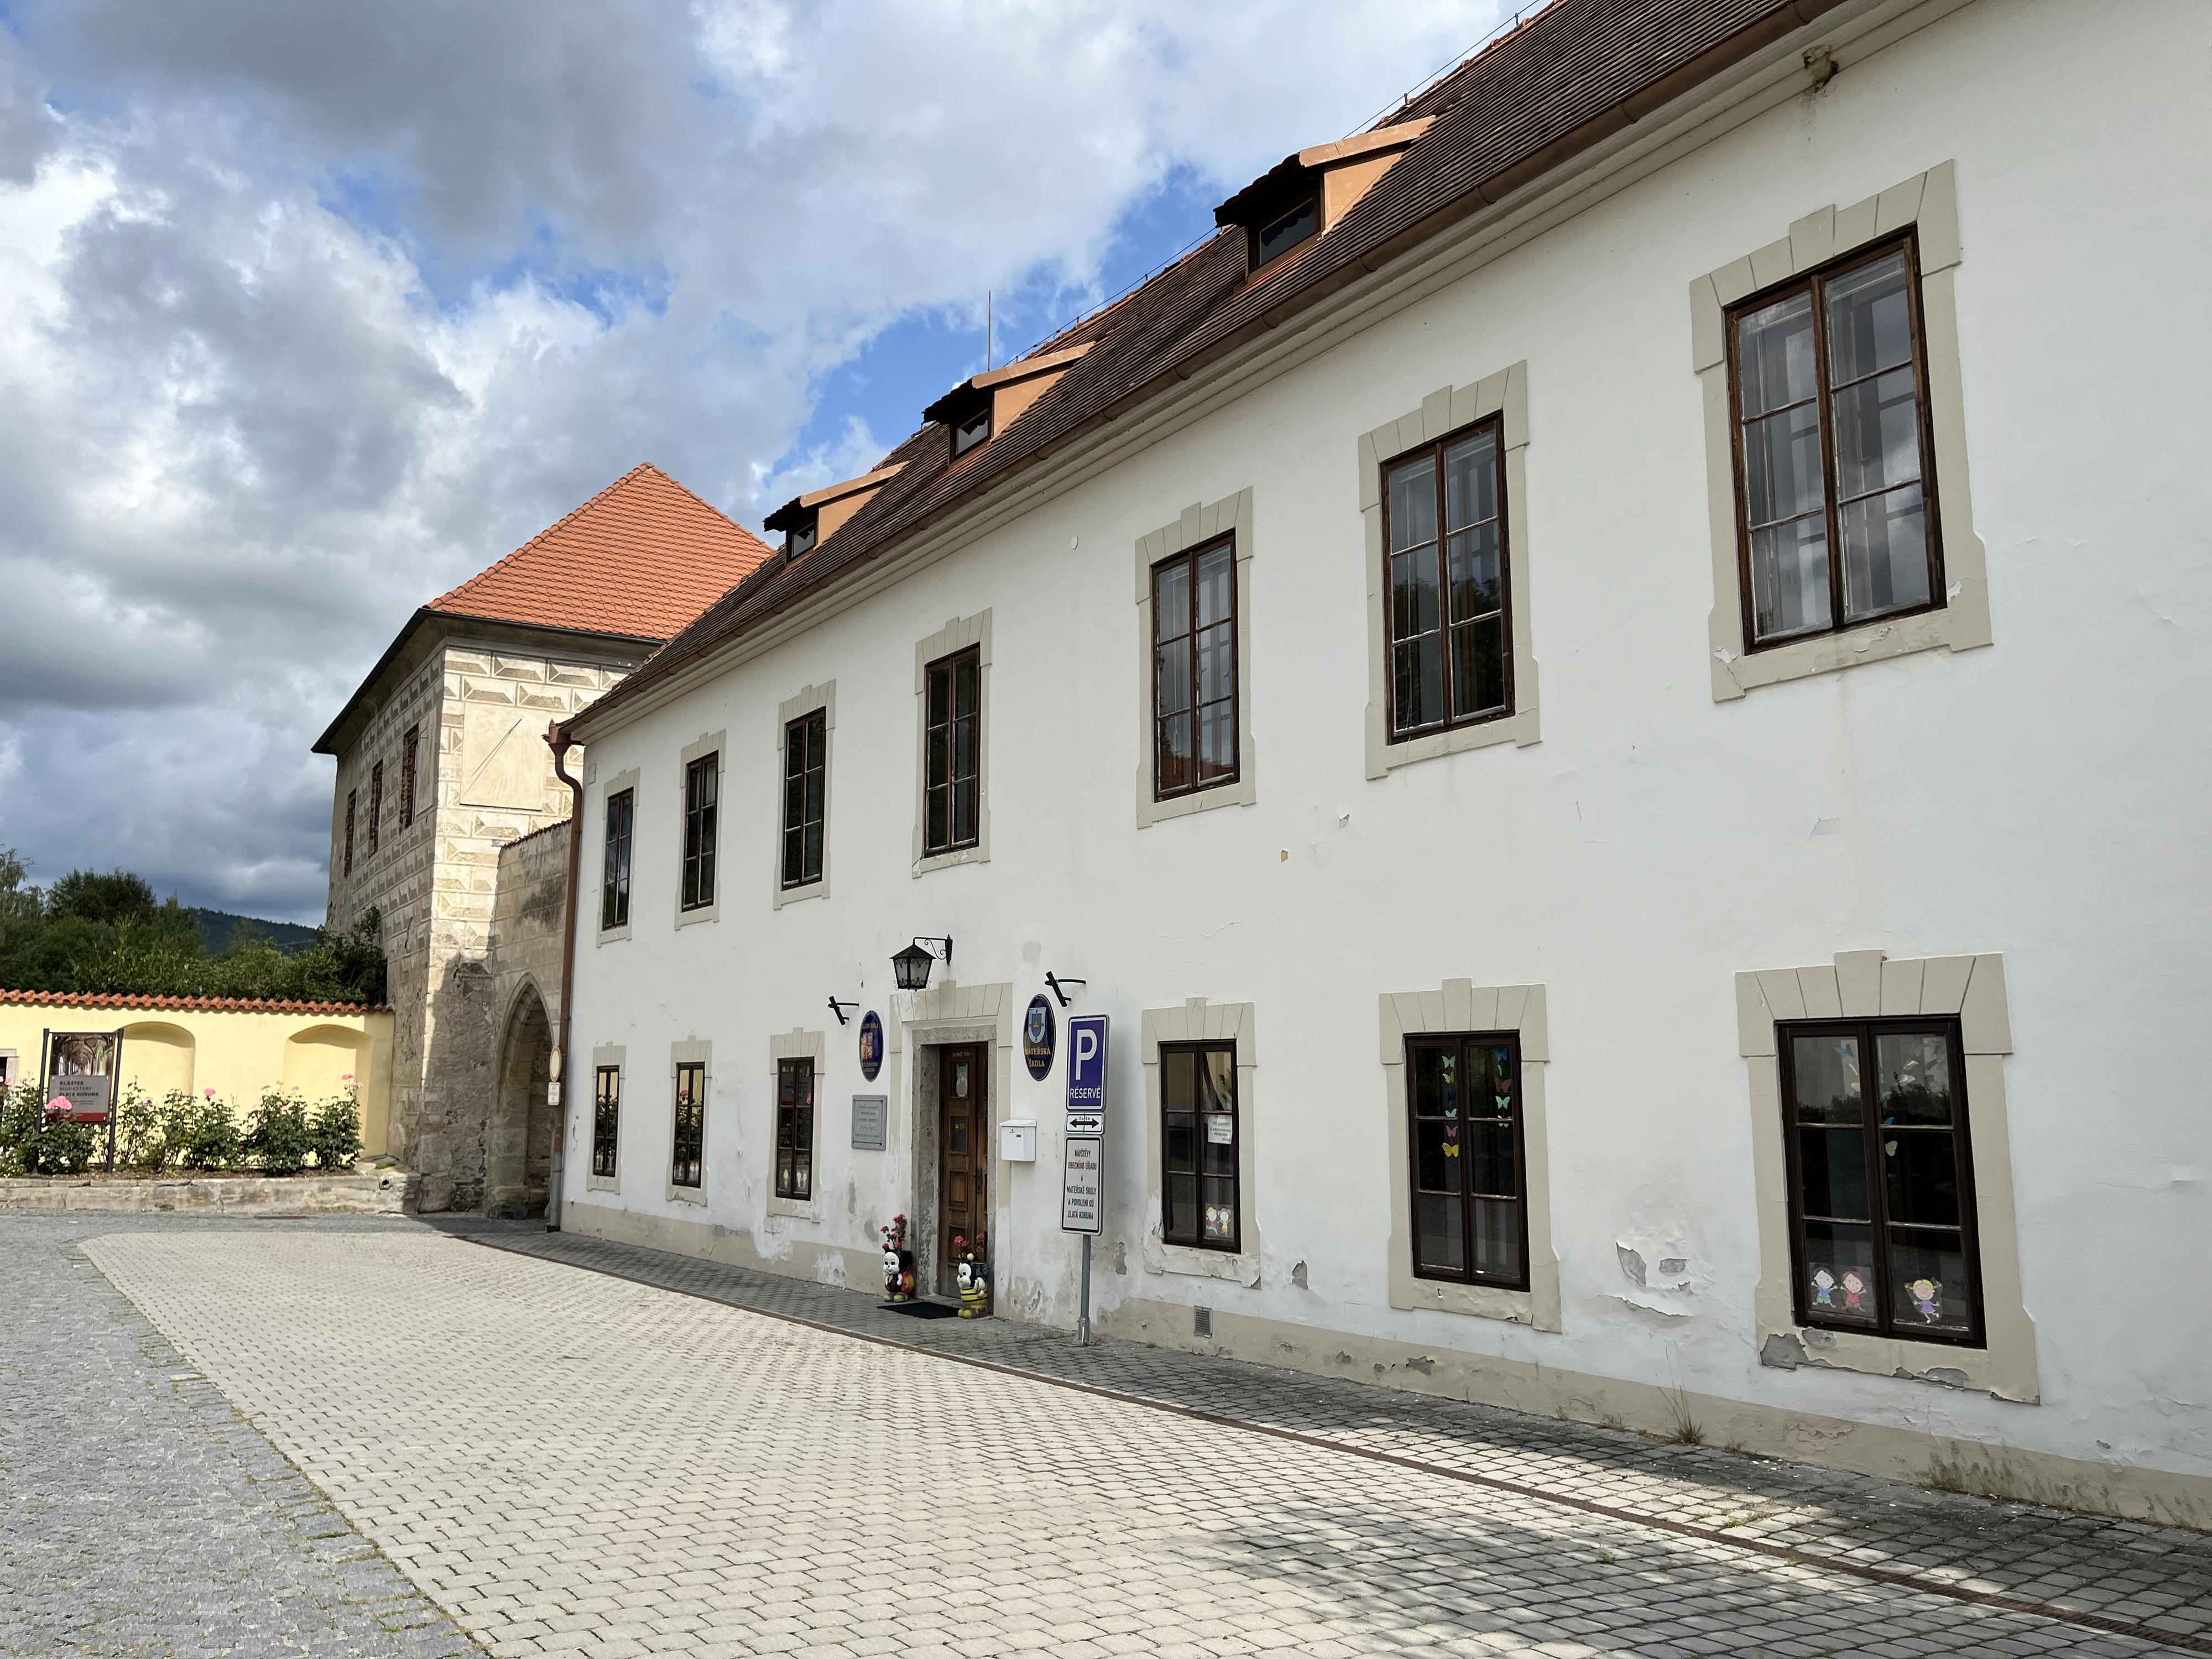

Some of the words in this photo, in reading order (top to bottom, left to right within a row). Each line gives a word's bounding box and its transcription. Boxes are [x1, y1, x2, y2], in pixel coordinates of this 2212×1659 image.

[1025, 1046, 1051, 1055] MATEŘSKÁ
[1076, 1029, 1098, 1080] P
[1029, 1058, 1045, 1067] ŠKOLA
[1070, 1086, 1101, 1099] RÉSERVÉ
